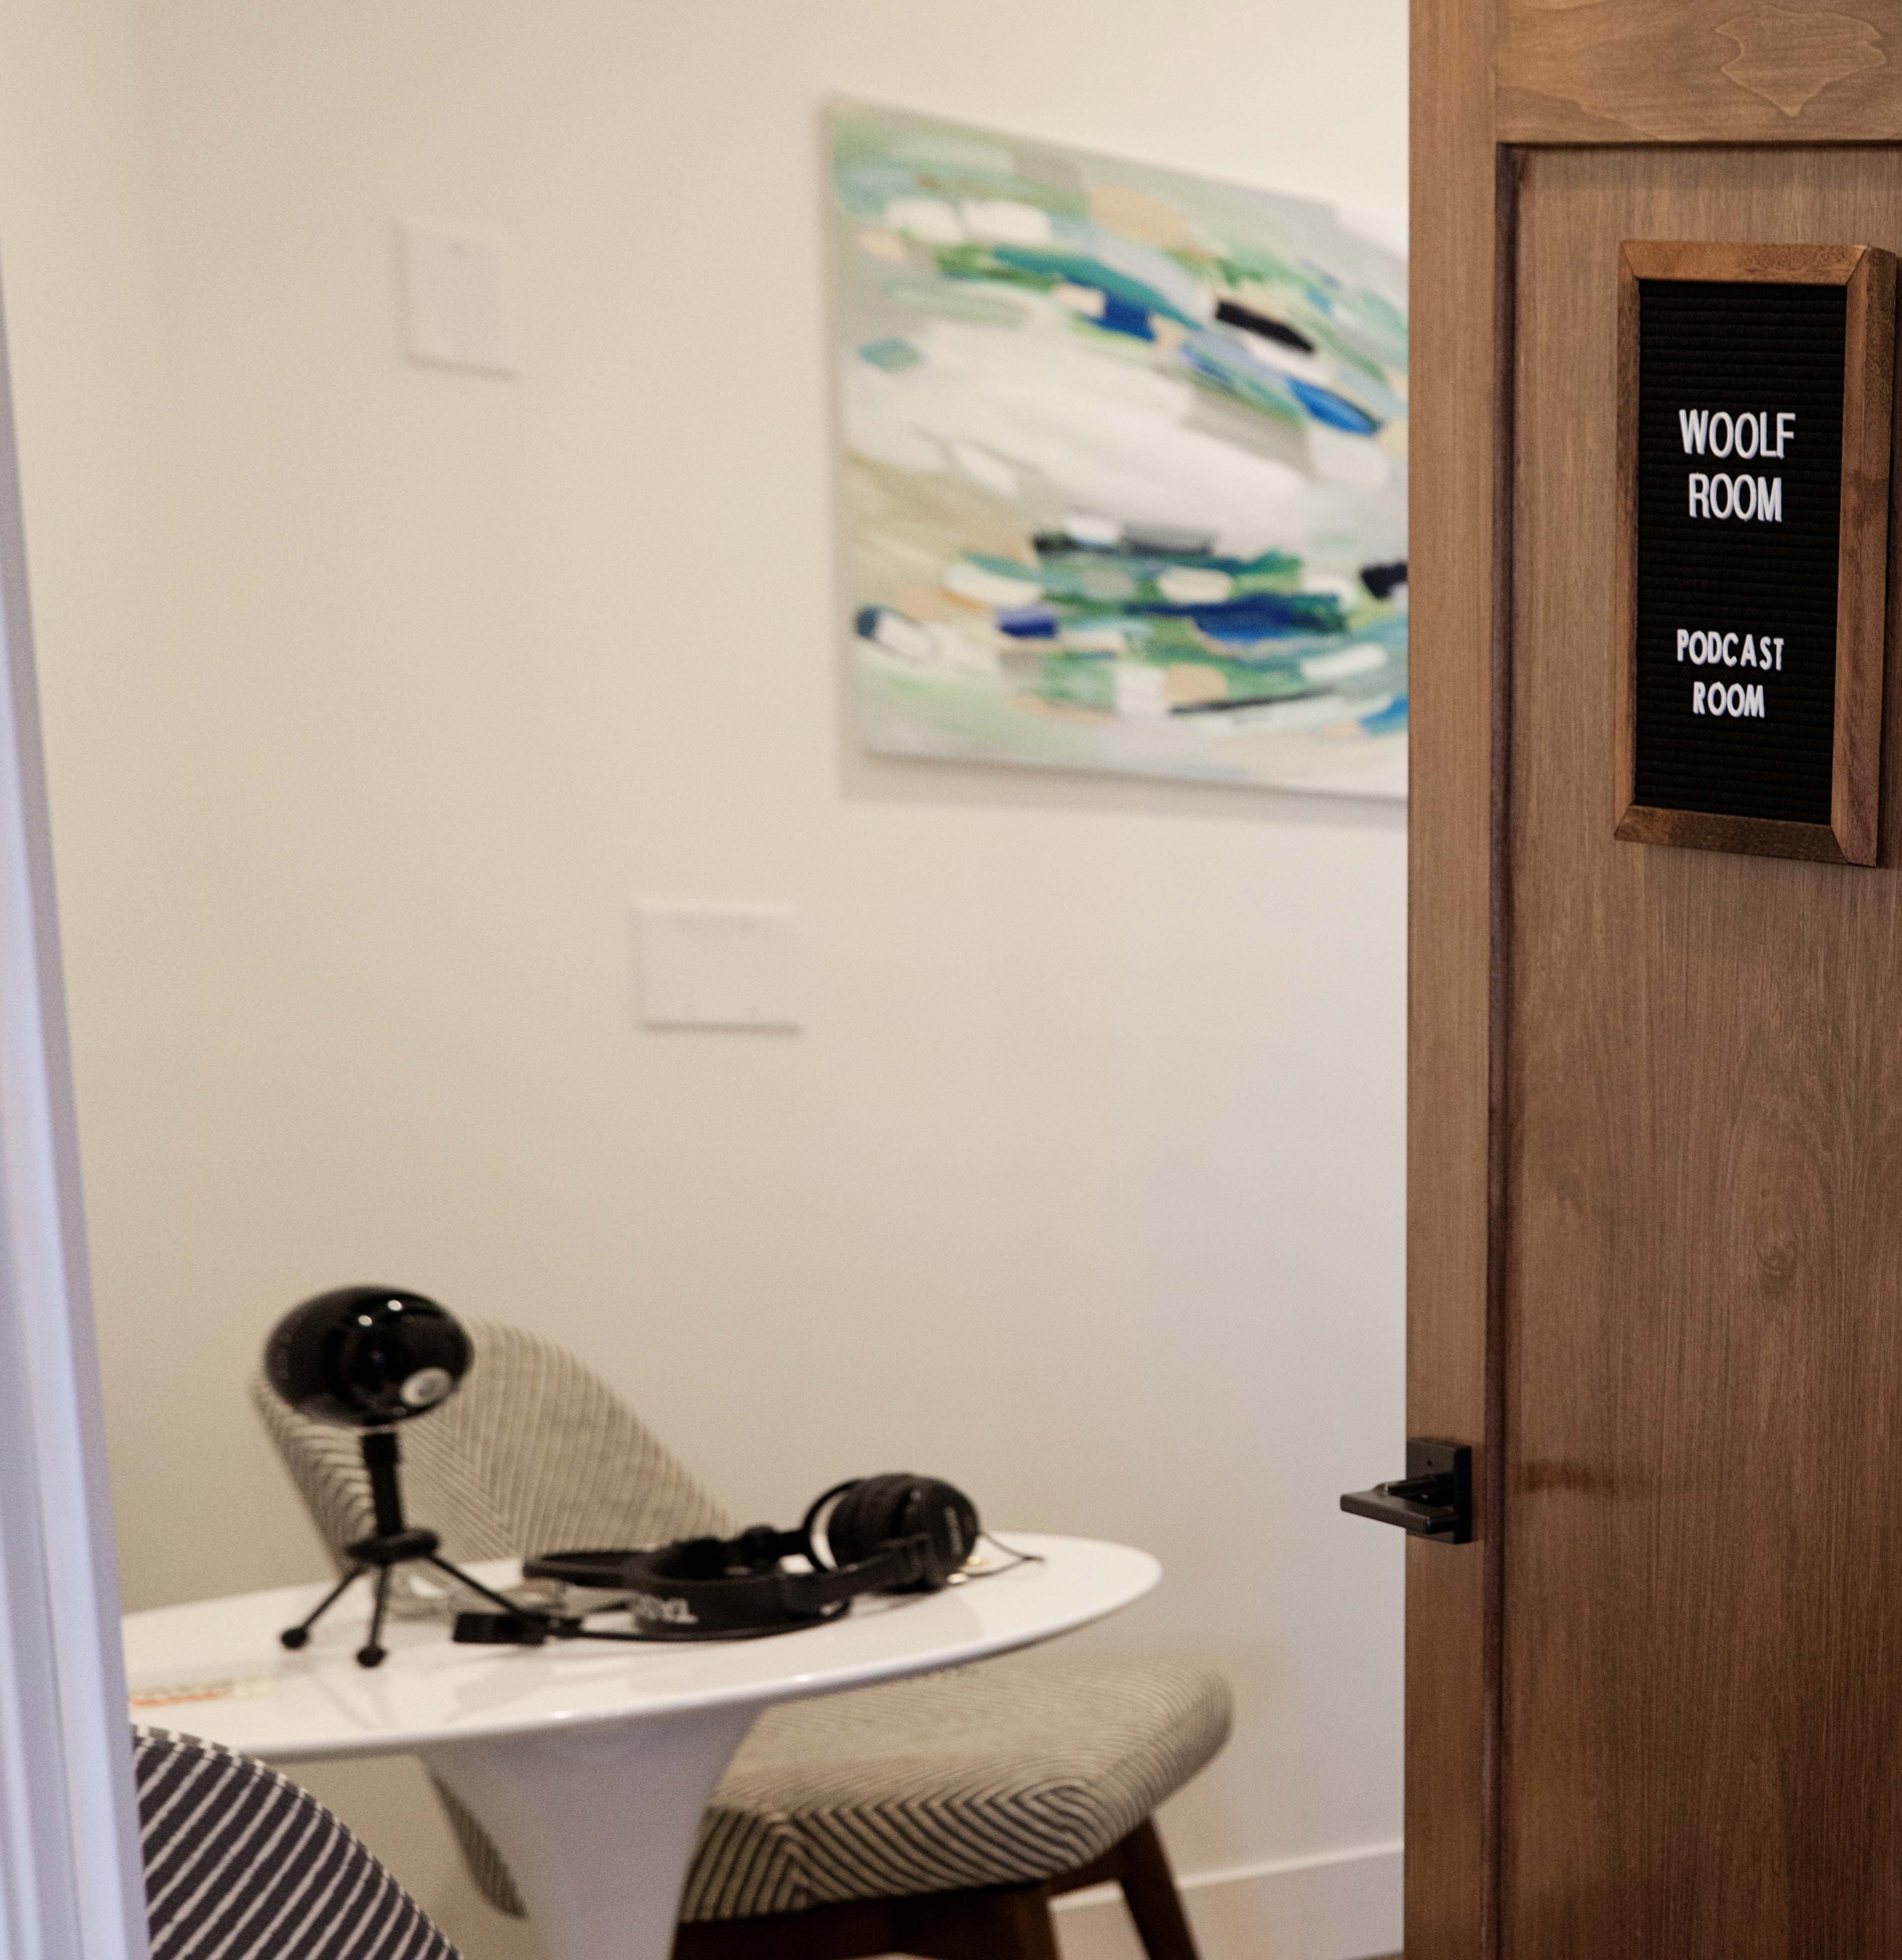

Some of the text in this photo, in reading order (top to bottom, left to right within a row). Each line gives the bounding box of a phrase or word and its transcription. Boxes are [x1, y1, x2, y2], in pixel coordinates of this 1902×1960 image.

[1679, 409, 1796, 459] WOOLF
[1688, 472, 1782, 522] ROOM
[1677, 629, 1785, 671] PODCAST
[1692, 681, 1765, 718] ROOM
